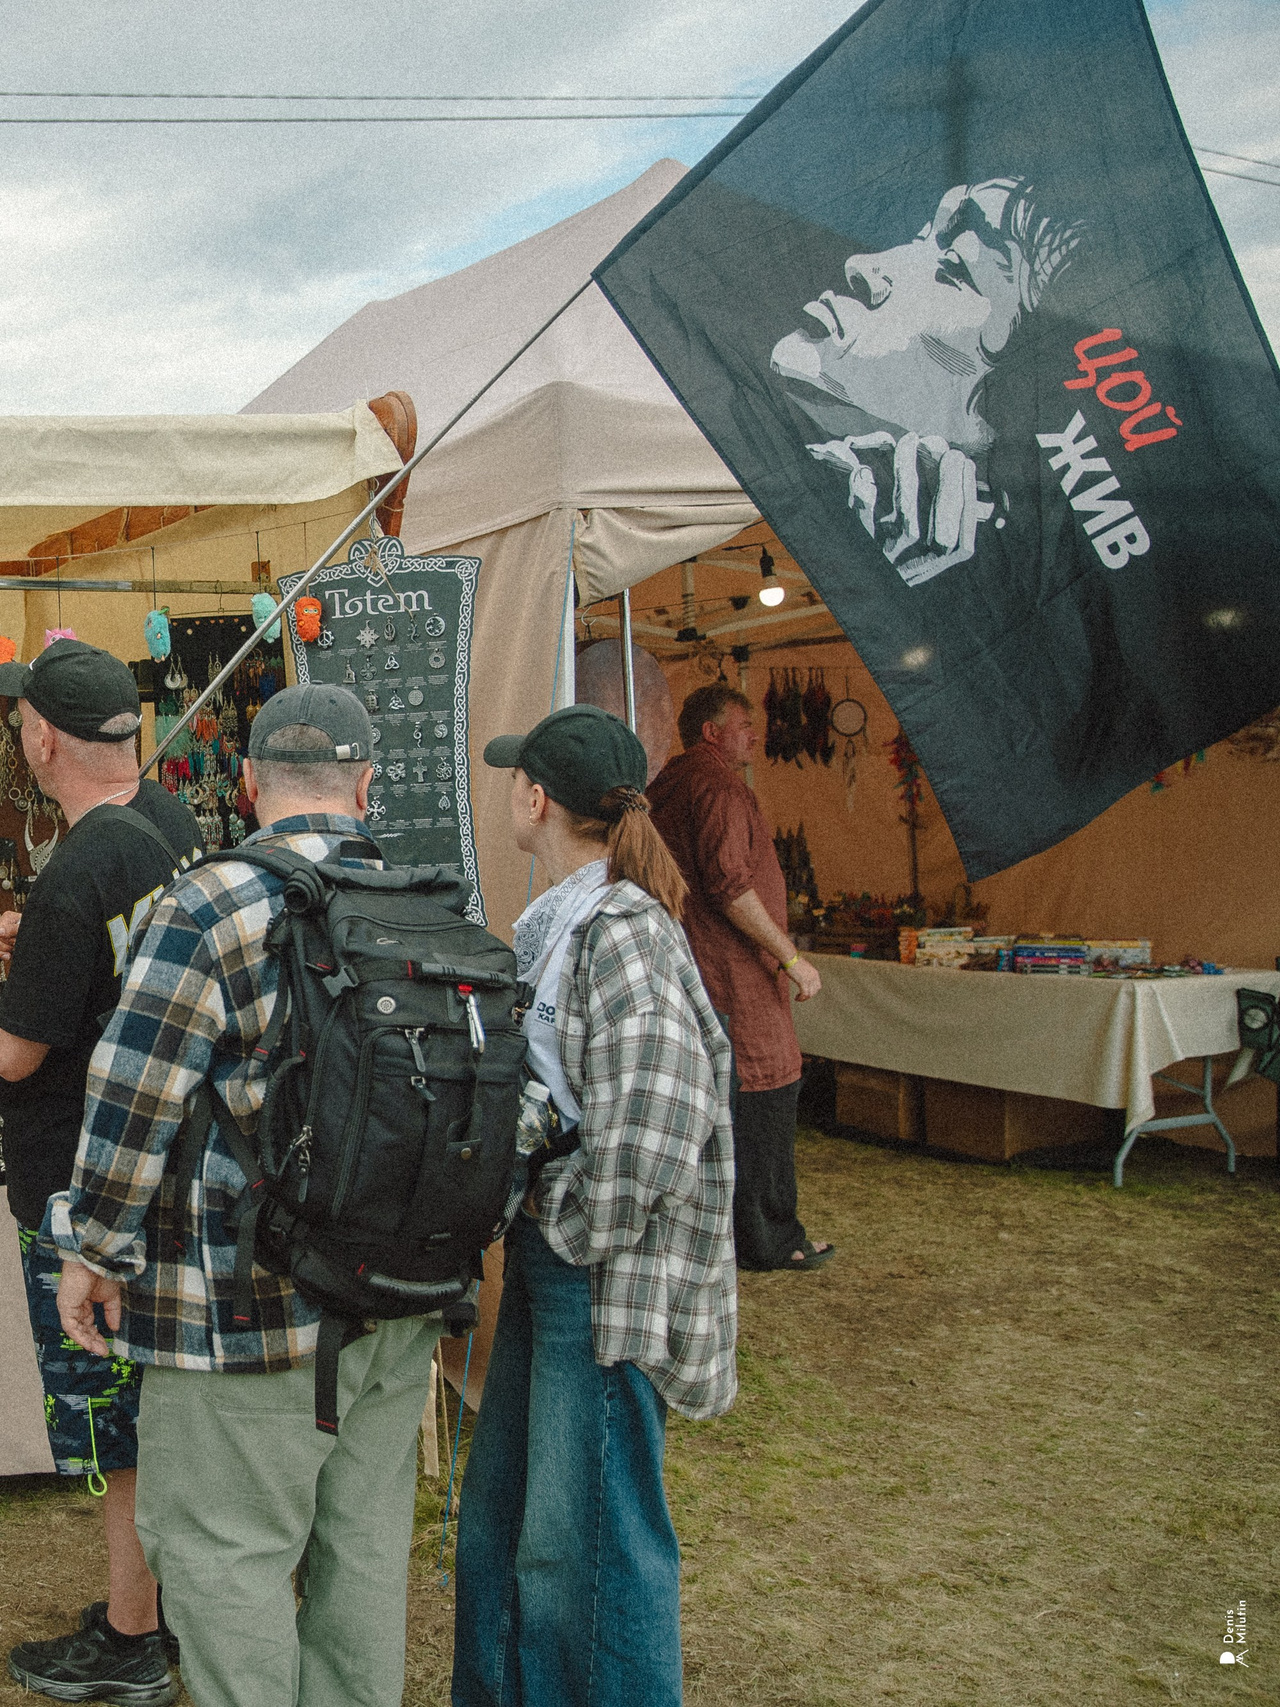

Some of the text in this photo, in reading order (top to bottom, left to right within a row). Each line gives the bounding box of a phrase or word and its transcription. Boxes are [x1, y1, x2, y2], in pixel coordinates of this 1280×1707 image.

[1063, 328, 1183, 452] ЦОЙ
[1035, 409, 1151, 570] ЖИВ
[324, 588, 433, 619] Totem
